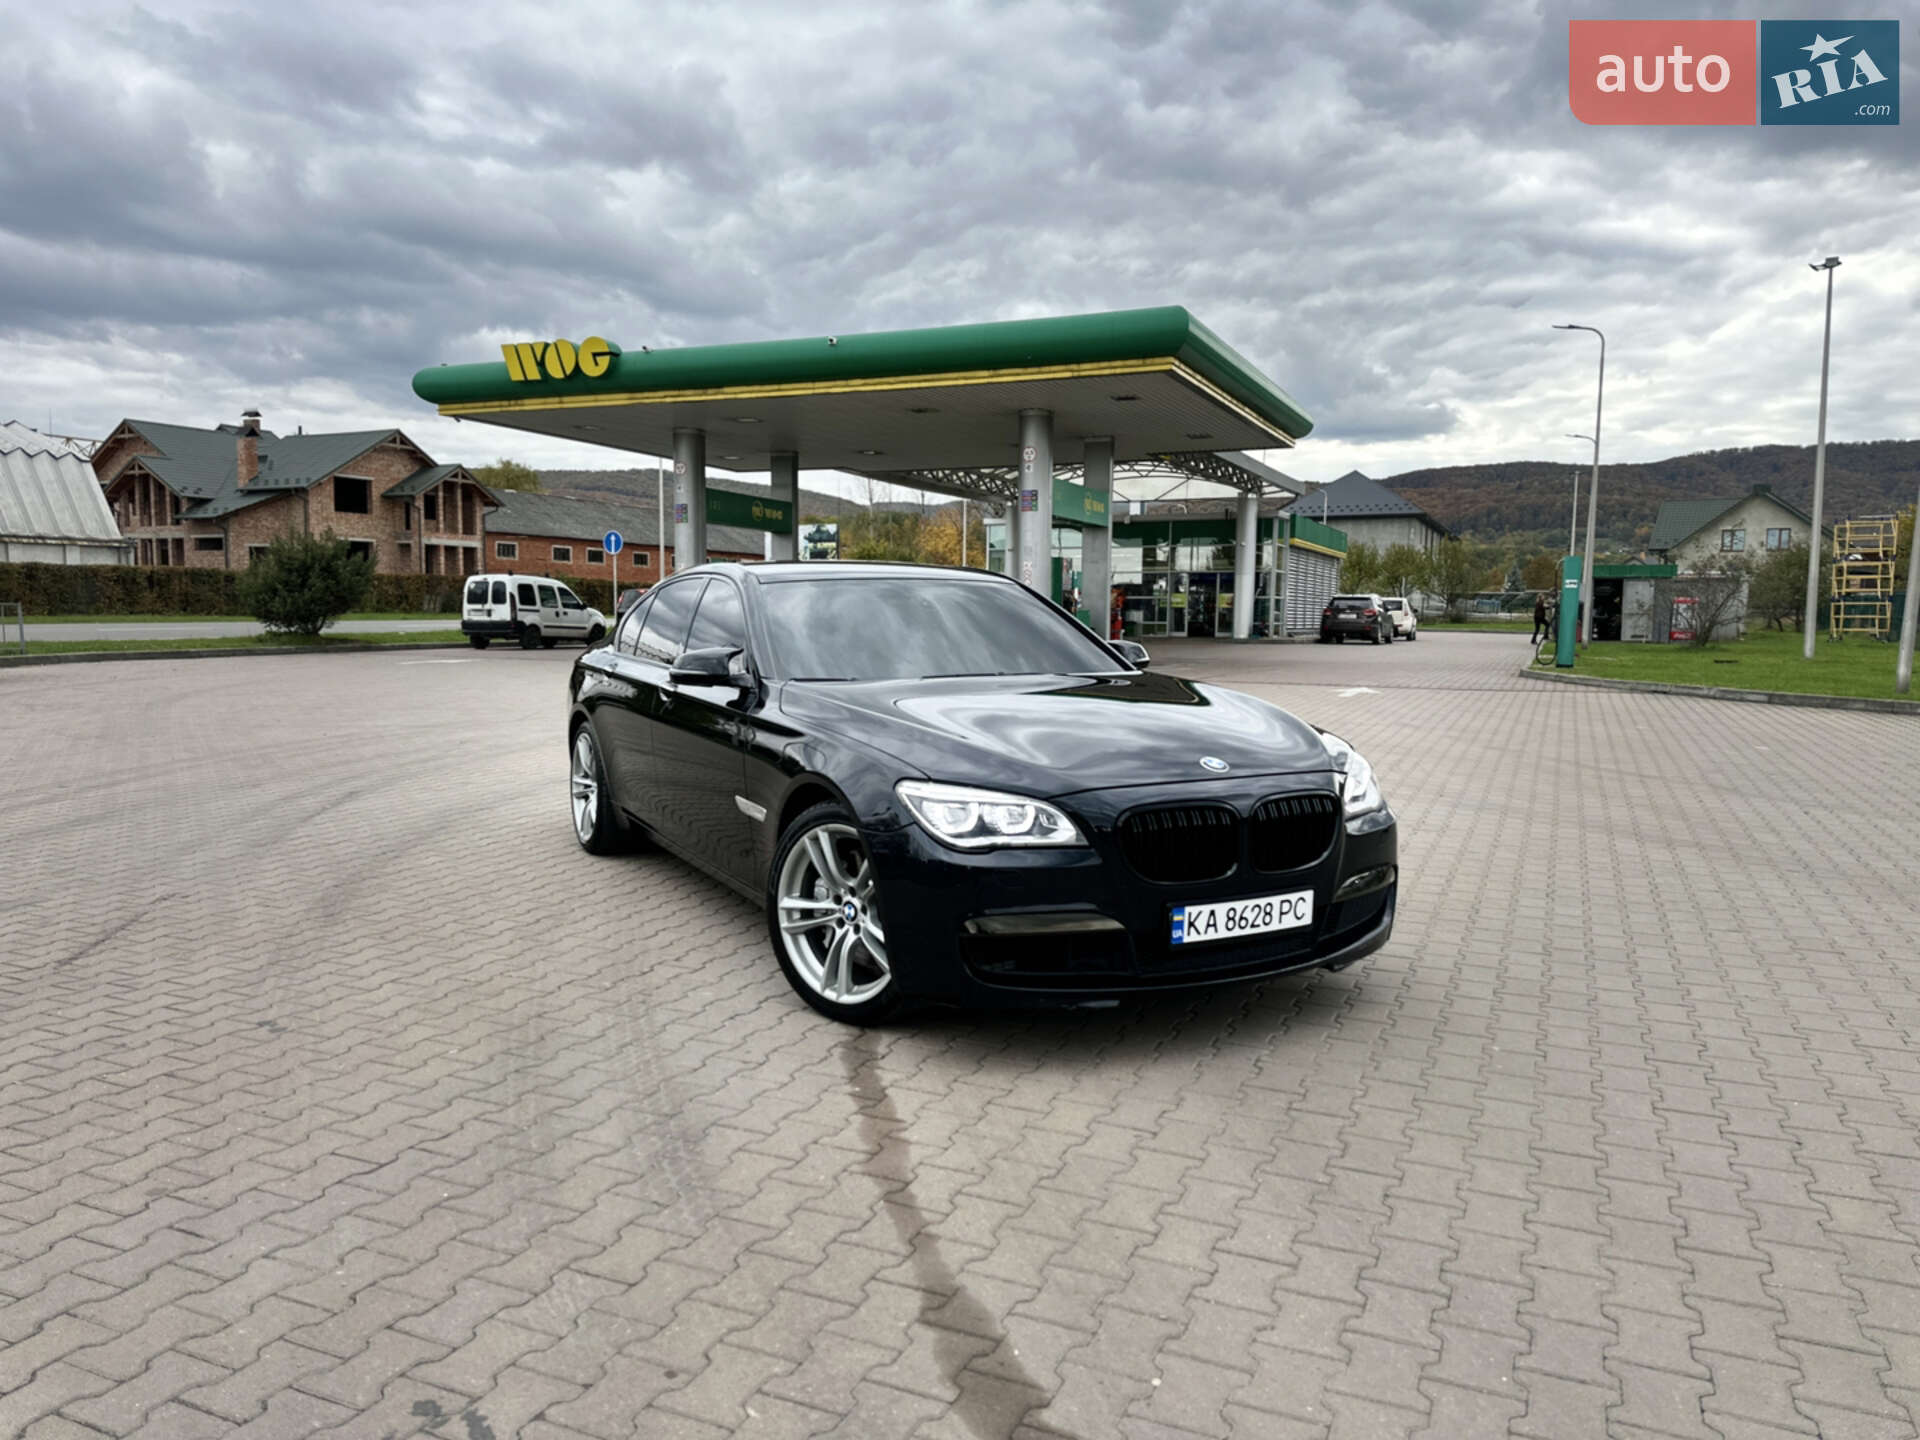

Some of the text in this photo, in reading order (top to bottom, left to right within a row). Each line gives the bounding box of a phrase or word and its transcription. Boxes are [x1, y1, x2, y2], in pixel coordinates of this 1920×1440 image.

[500, 336, 611, 382] WOG
[1186, 896, 1307, 937] KA 8628 PC
